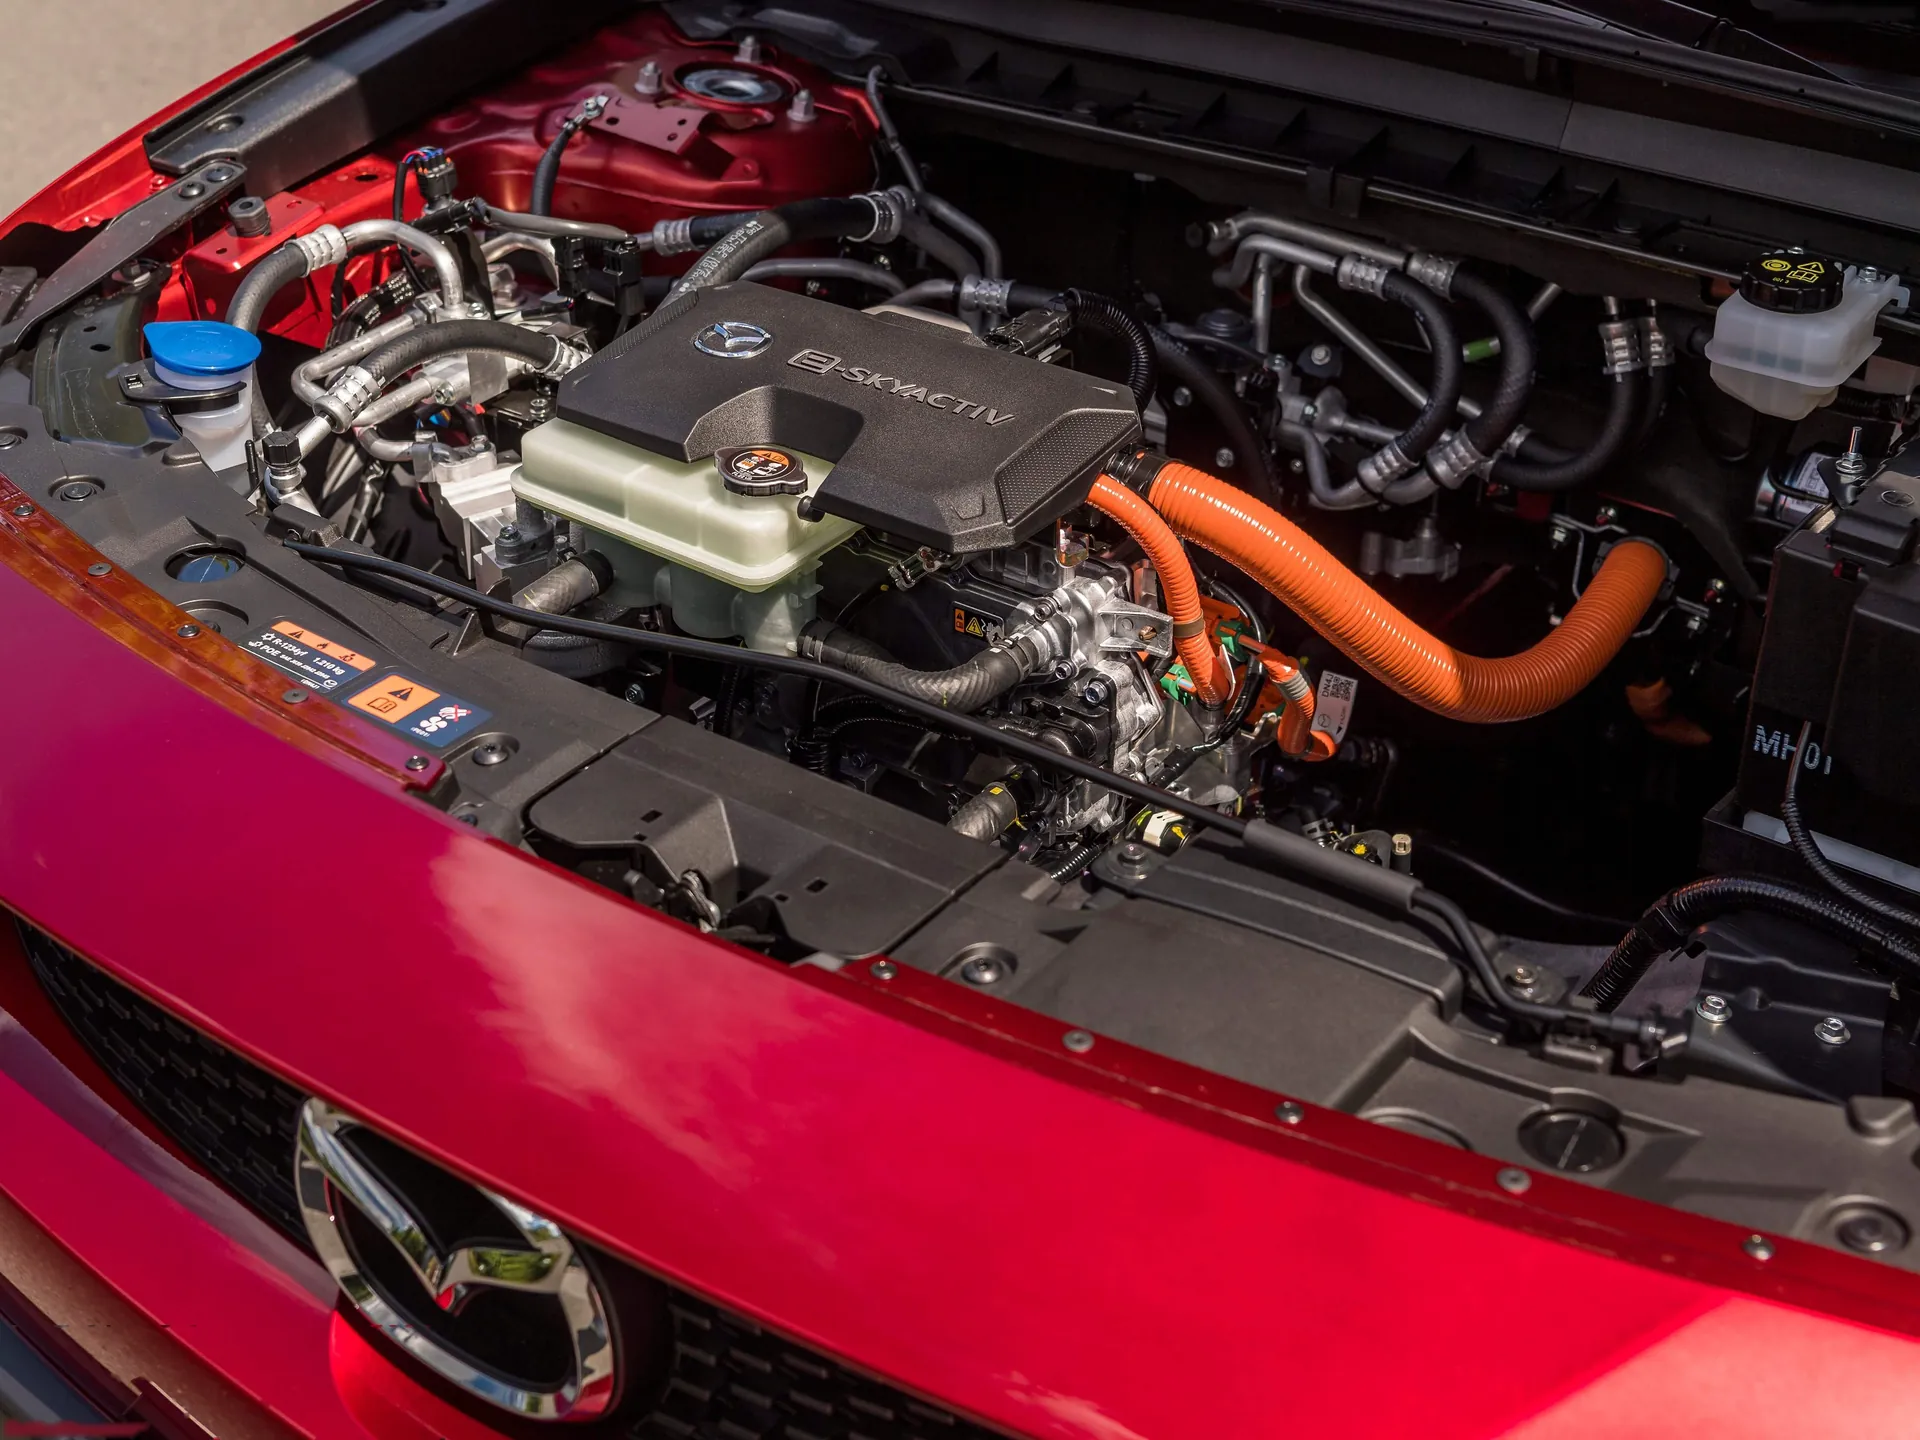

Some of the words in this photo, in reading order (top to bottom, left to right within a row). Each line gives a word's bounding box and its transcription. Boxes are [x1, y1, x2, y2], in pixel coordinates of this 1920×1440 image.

[260, 645, 282, 657] POE
[332, 666, 346, 676] kg
[1321, 673, 1334, 698] DN4J
